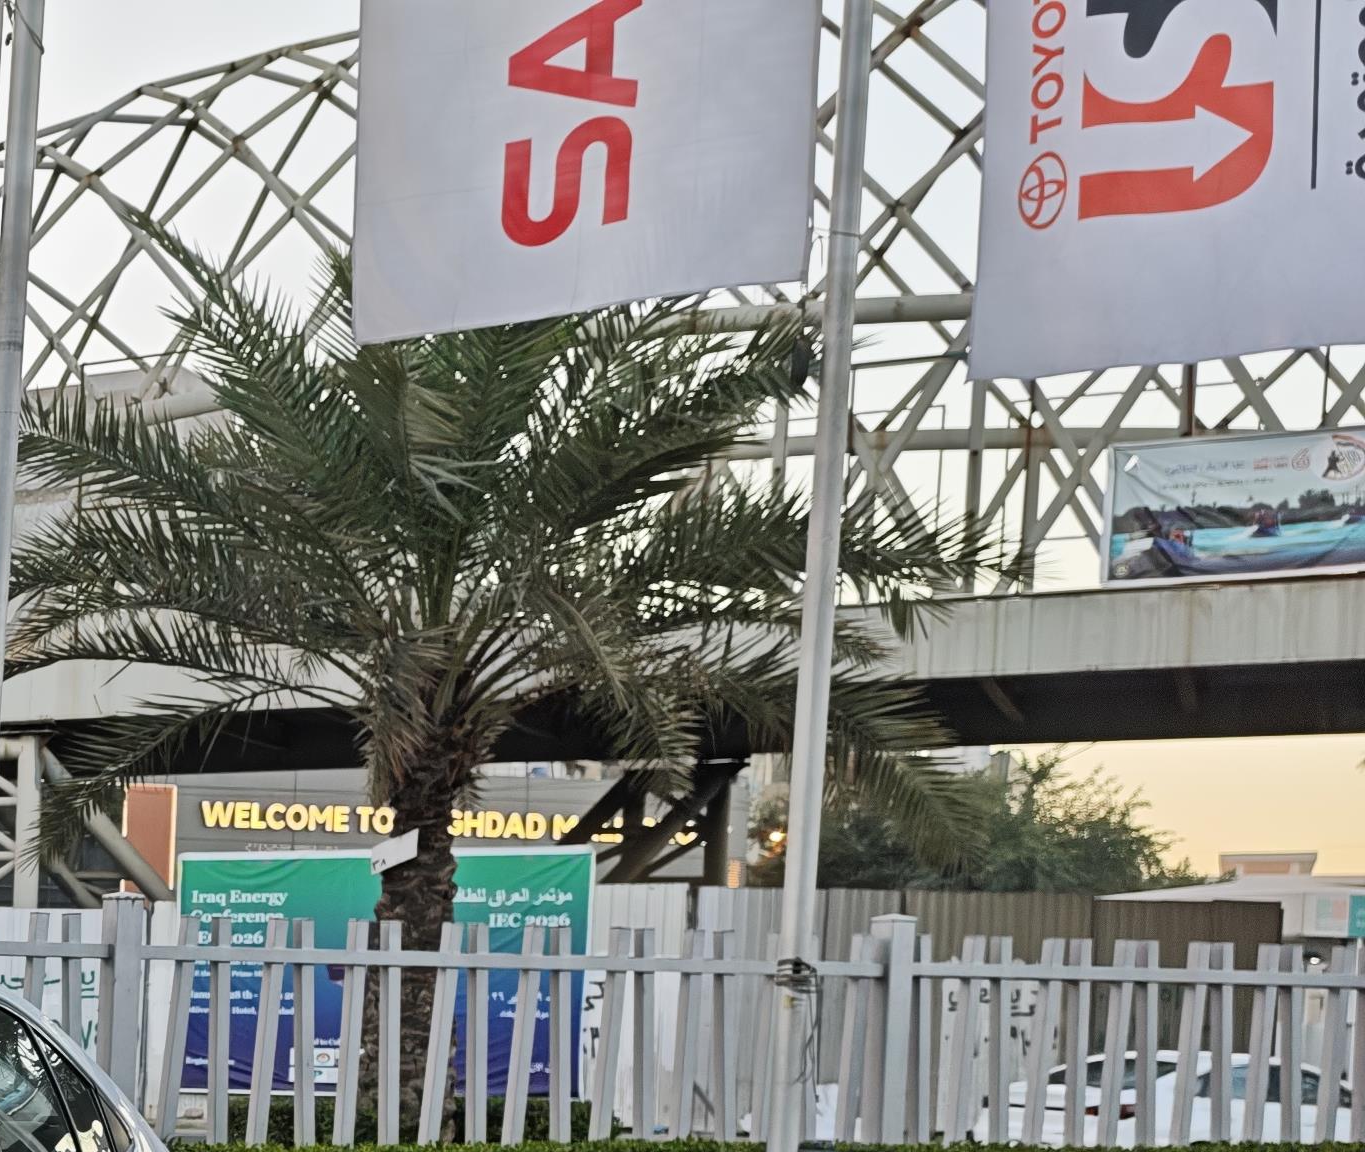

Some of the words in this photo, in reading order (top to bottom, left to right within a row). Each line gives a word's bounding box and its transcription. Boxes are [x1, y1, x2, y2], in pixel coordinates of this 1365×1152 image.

[201, 799, 351, 834] WELCOME
[355, 805, 396, 835] TO
[191, 890, 226, 905] Iraq
[229, 889, 289, 906] Energy
[488, 912, 522, 929] IEC
